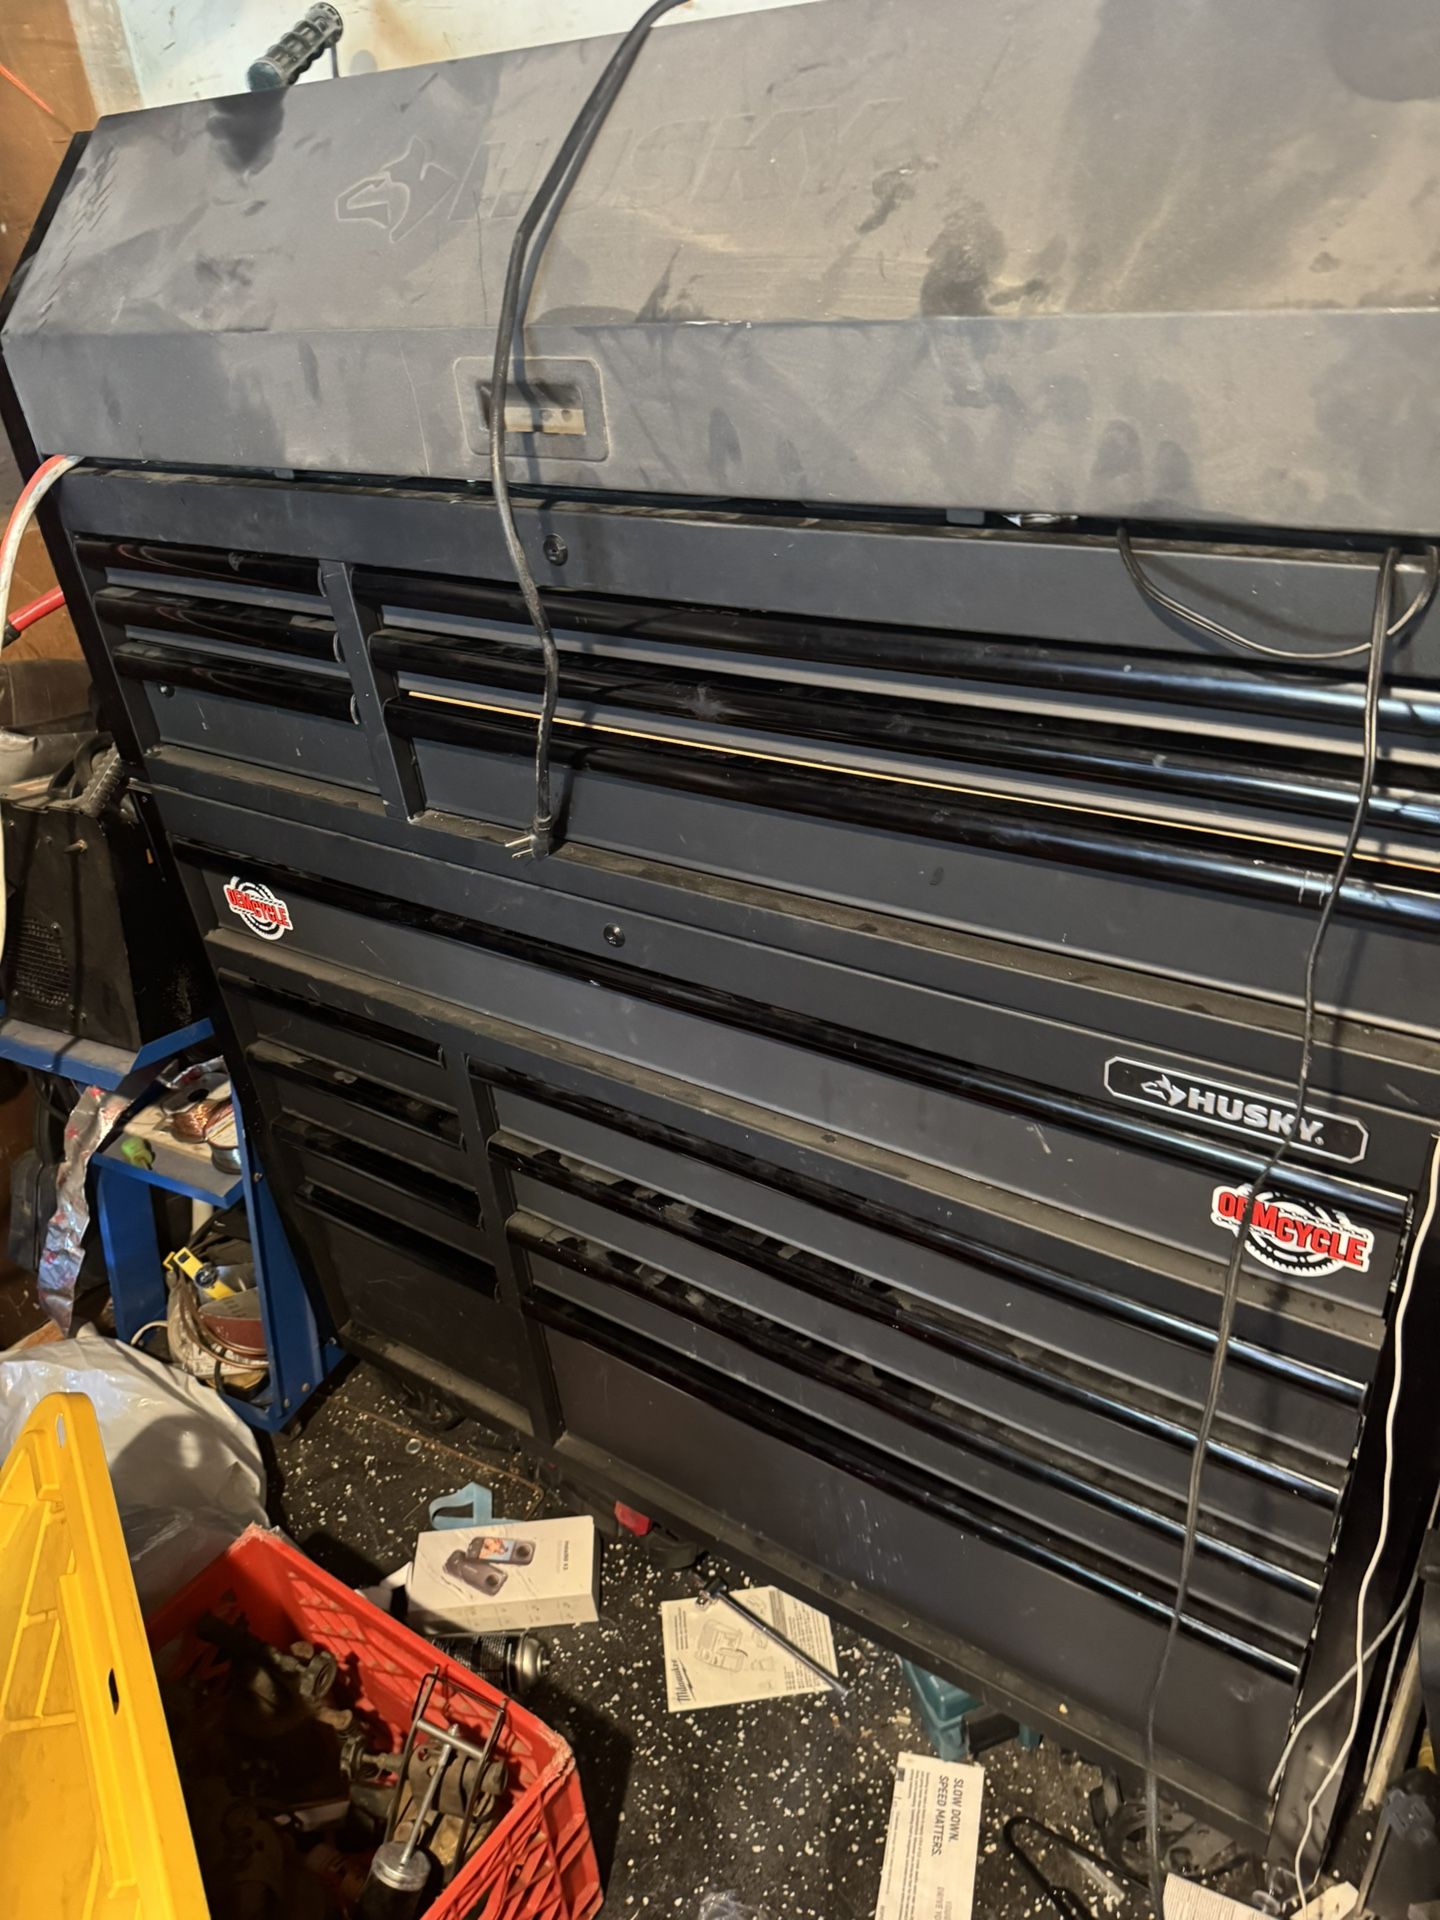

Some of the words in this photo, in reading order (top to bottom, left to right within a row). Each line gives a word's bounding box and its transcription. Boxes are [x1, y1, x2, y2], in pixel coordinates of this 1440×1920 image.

[1187, 1087, 1324, 1143] HUSKY
[937, 1775, 949, 1806] SPEED
[950, 1778, 964, 1809] SLOW
